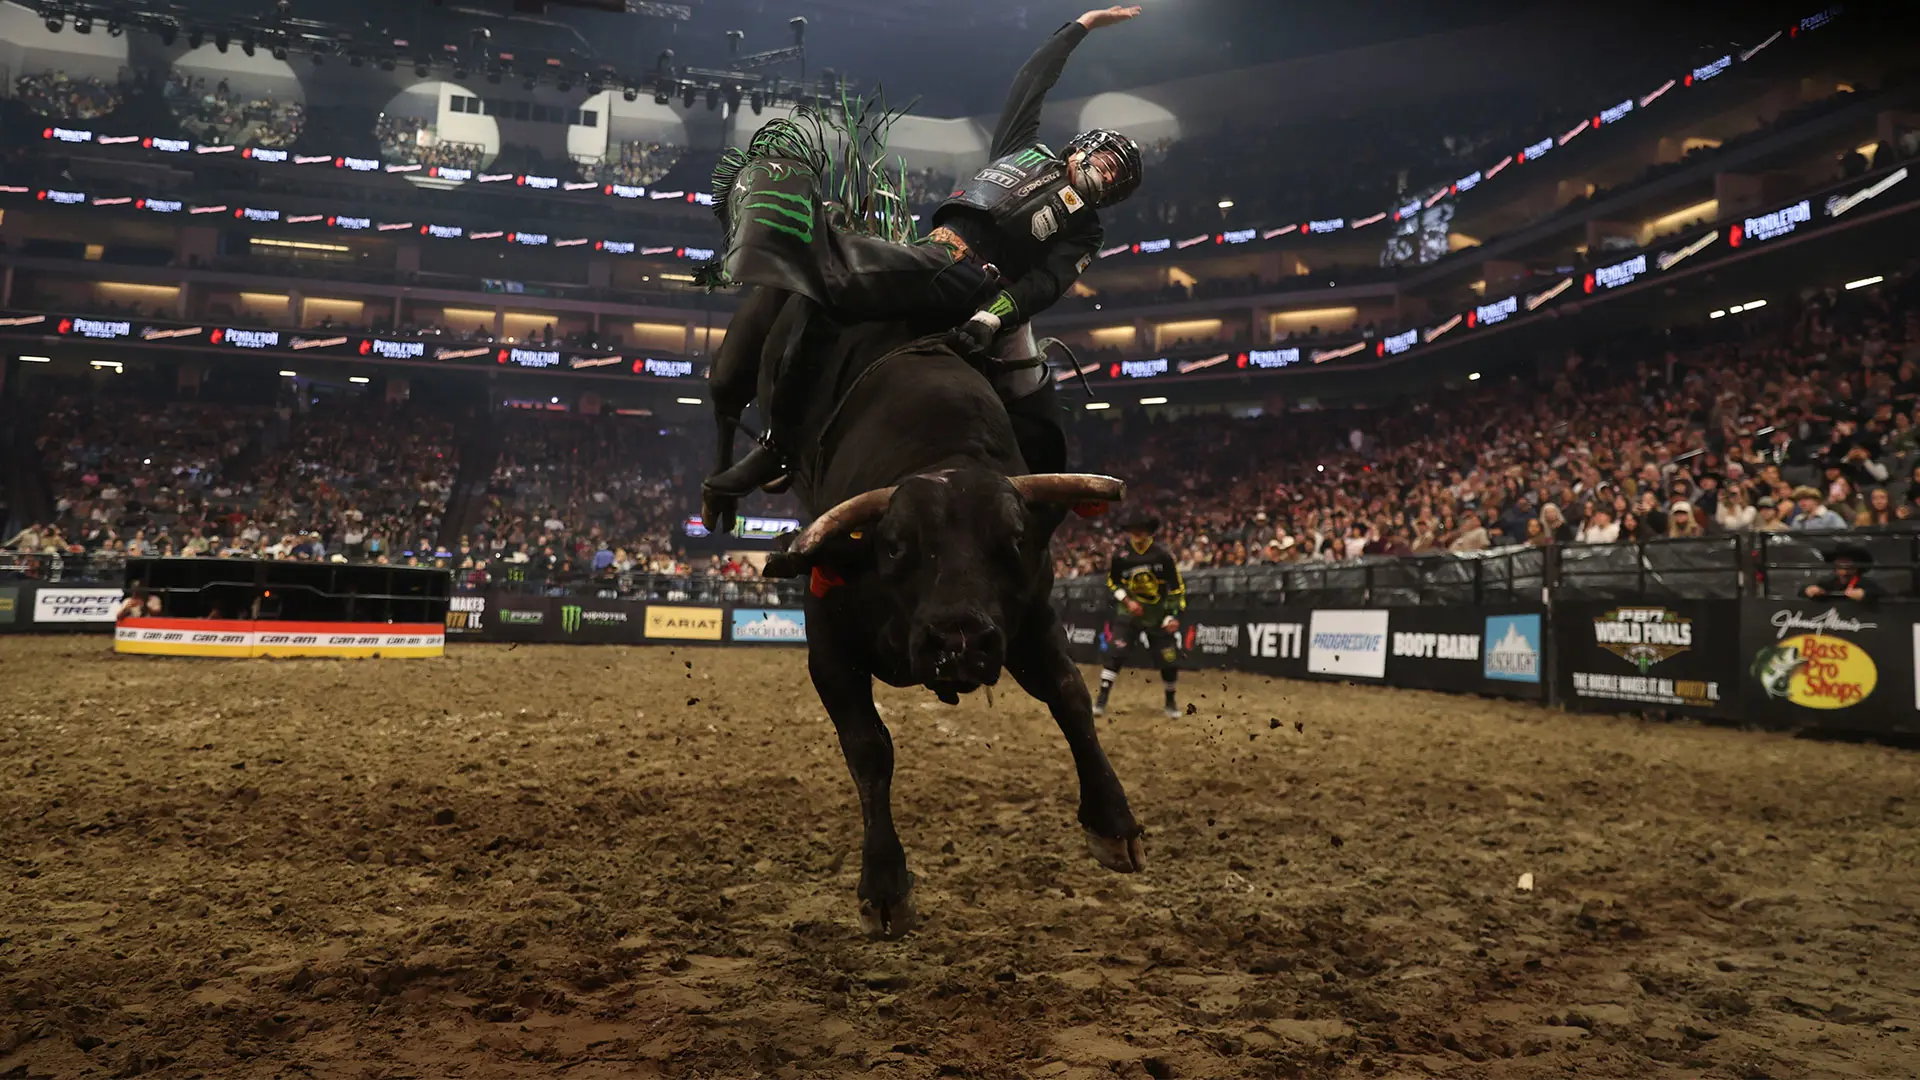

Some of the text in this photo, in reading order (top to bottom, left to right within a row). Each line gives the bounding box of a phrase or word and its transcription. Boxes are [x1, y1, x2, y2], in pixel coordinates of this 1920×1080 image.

[981, 171, 1016, 186] YETI
[1744, 200, 1811, 239] PENDLETON
[1595, 254, 1647, 286] PENDLETON
[73, 318, 131, 336] PENDLETON
[224, 328, 279, 346] PENDLETON
[372, 339, 425, 356] PENDLETON
[510, 348, 560, 365] PENDLETON
[644, 358, 692, 375] PENDLETON
[42, 595, 123, 605] COOPER
[450, 596, 485, 612] MAKES
[53, 606, 109, 616] TIRES
[468, 612, 483, 629] IT.
[666, 619, 717, 629] ARIAT
[192, 634, 244, 643] can-am
[259, 635, 317, 644] can-am
[328, 636, 380, 645] can-am
[1195, 623, 1239, 648] PENDLETON
[1247, 622, 1303, 658] YETI
[1594, 621, 1692, 645] WORLD FINALS
[1393, 632, 1480, 660] BOOT BARN
[1802, 637, 1849, 660] Bass
[1803, 657, 1839, 679] Pro
[1803, 676, 1863, 703] Shops
